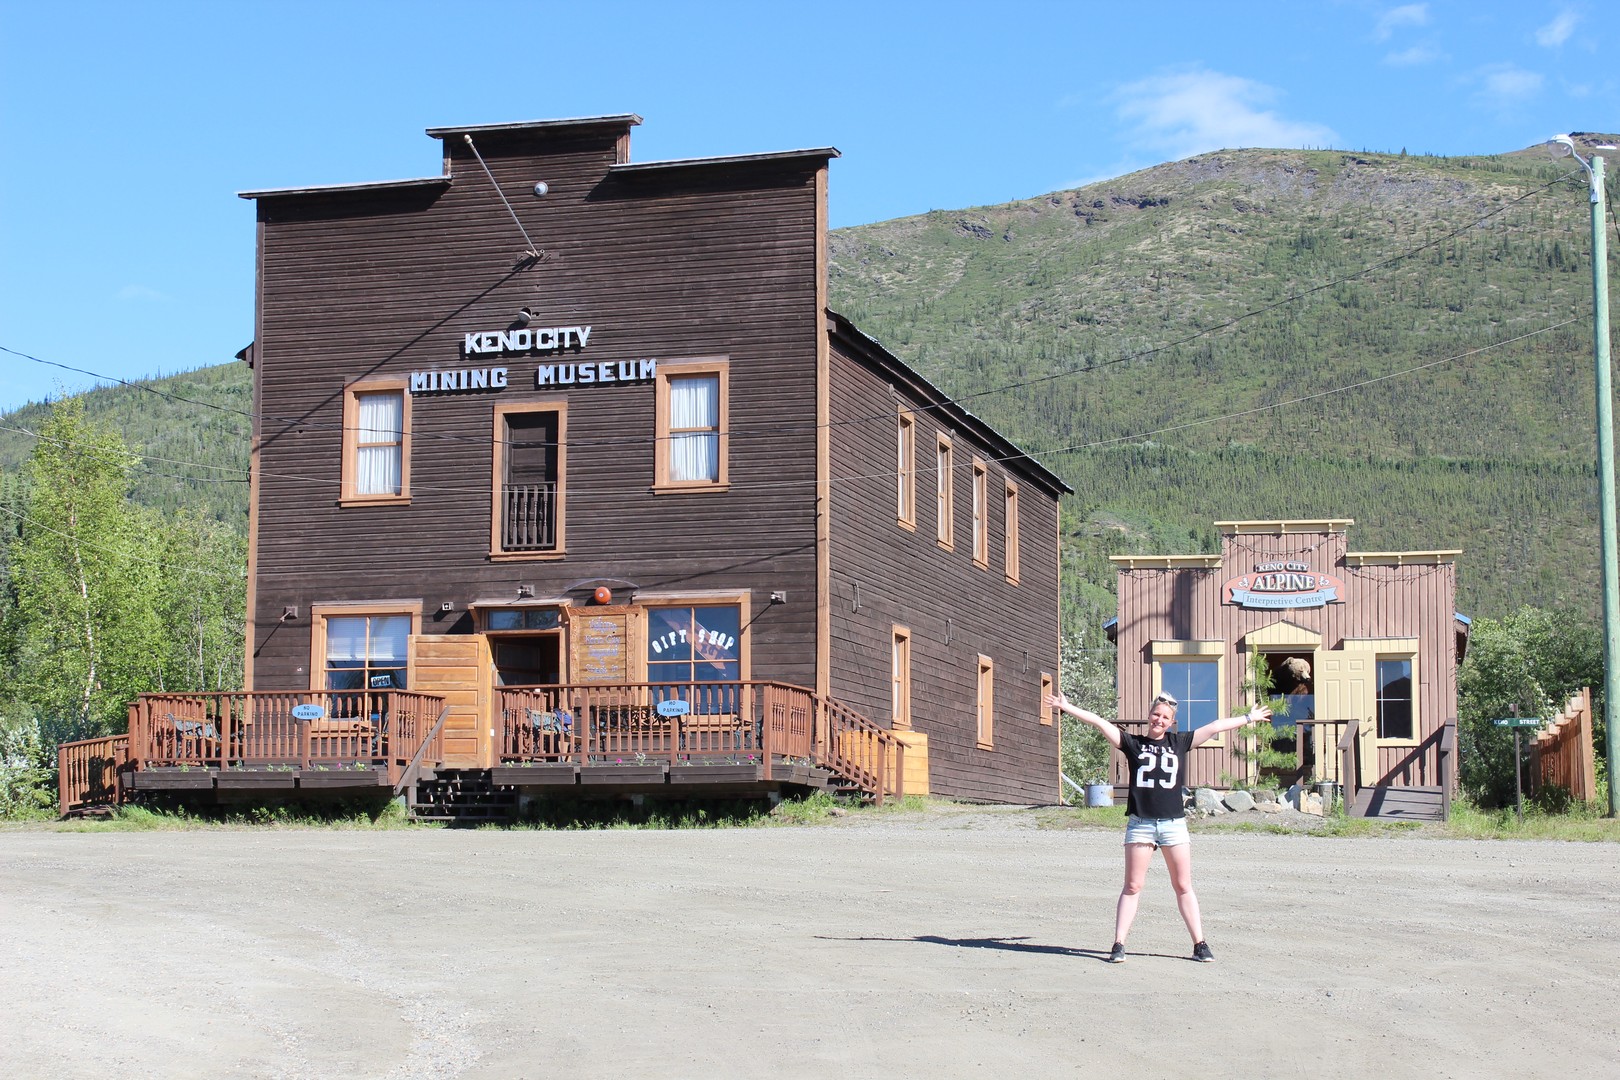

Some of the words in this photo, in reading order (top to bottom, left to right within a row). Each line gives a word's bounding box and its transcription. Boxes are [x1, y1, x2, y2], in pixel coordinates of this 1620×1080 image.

[465, 329, 531, 354] KENO
[536, 326, 592, 350] CITY
[410, 368, 508, 392] MINING
[538, 359, 657, 385] MUSEUM
[1258, 562, 1284, 572] KENO
[1286, 562, 1309, 571] CITY
[1252, 573, 1316, 591] ALPINE
[1245, 595, 1293, 606] Interpretive
[1295, 596, 1323, 604] Centre
[651, 629, 687, 653] GIFT
[698, 628, 735, 650] SHOP
[372, 676, 389, 686] OPEN
[1136, 752, 1179, 789] 29
